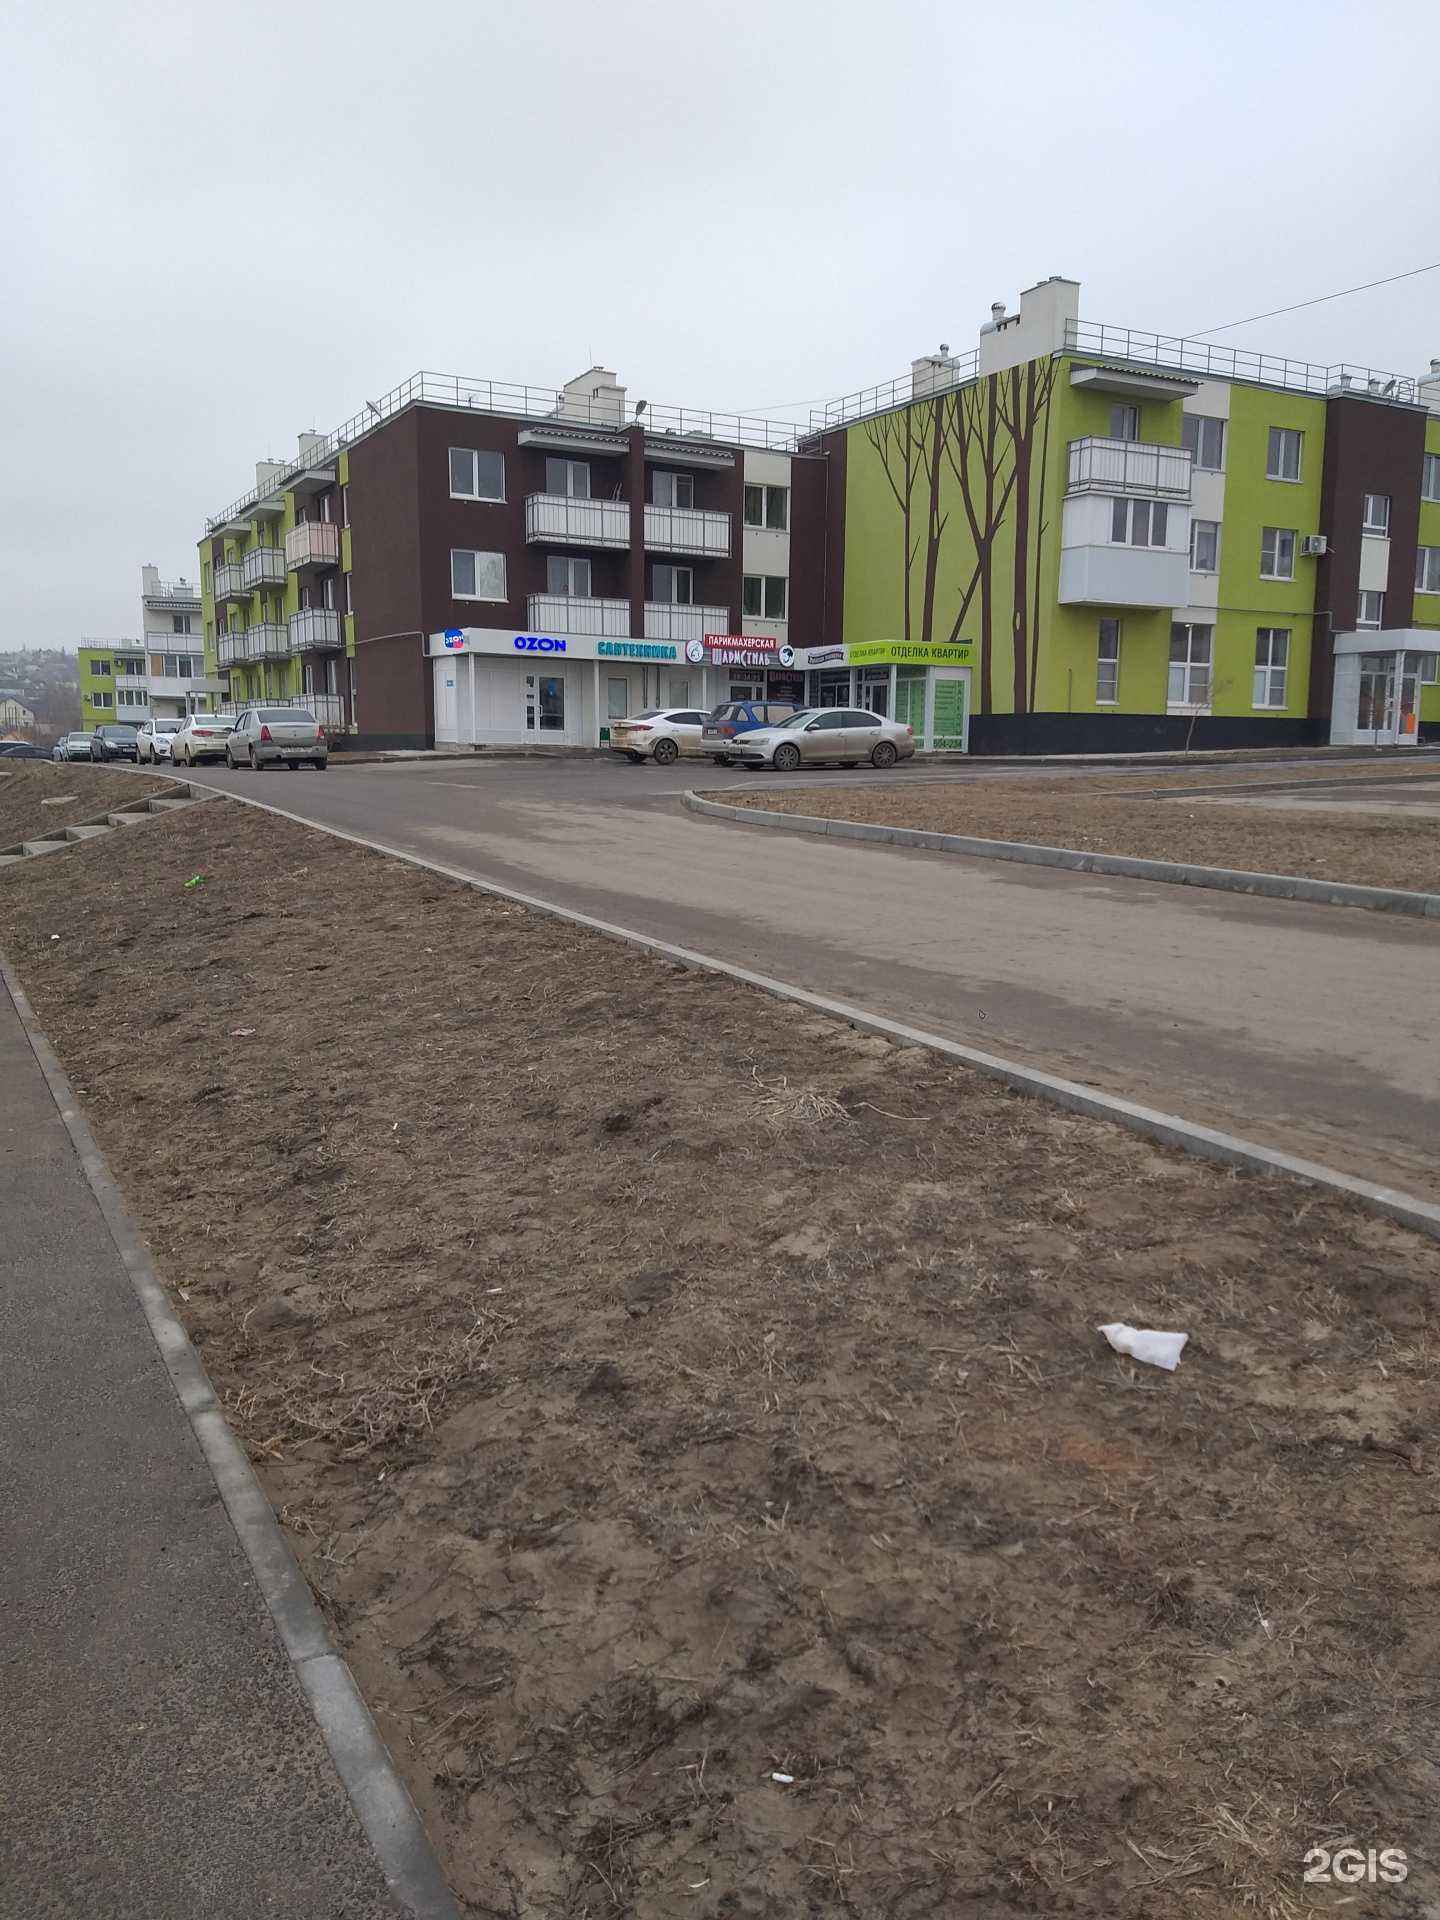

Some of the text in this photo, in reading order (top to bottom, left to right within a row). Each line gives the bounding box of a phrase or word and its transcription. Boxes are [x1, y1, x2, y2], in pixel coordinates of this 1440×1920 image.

[514, 636, 567, 652] OZON
[708, 636, 774, 649] ПАРИКМАХЕРСКАЯ
[597, 641, 677, 660] САНТЕХНИКА
[891, 647, 969, 659] ОТДЕЛКА КВАРТИР
